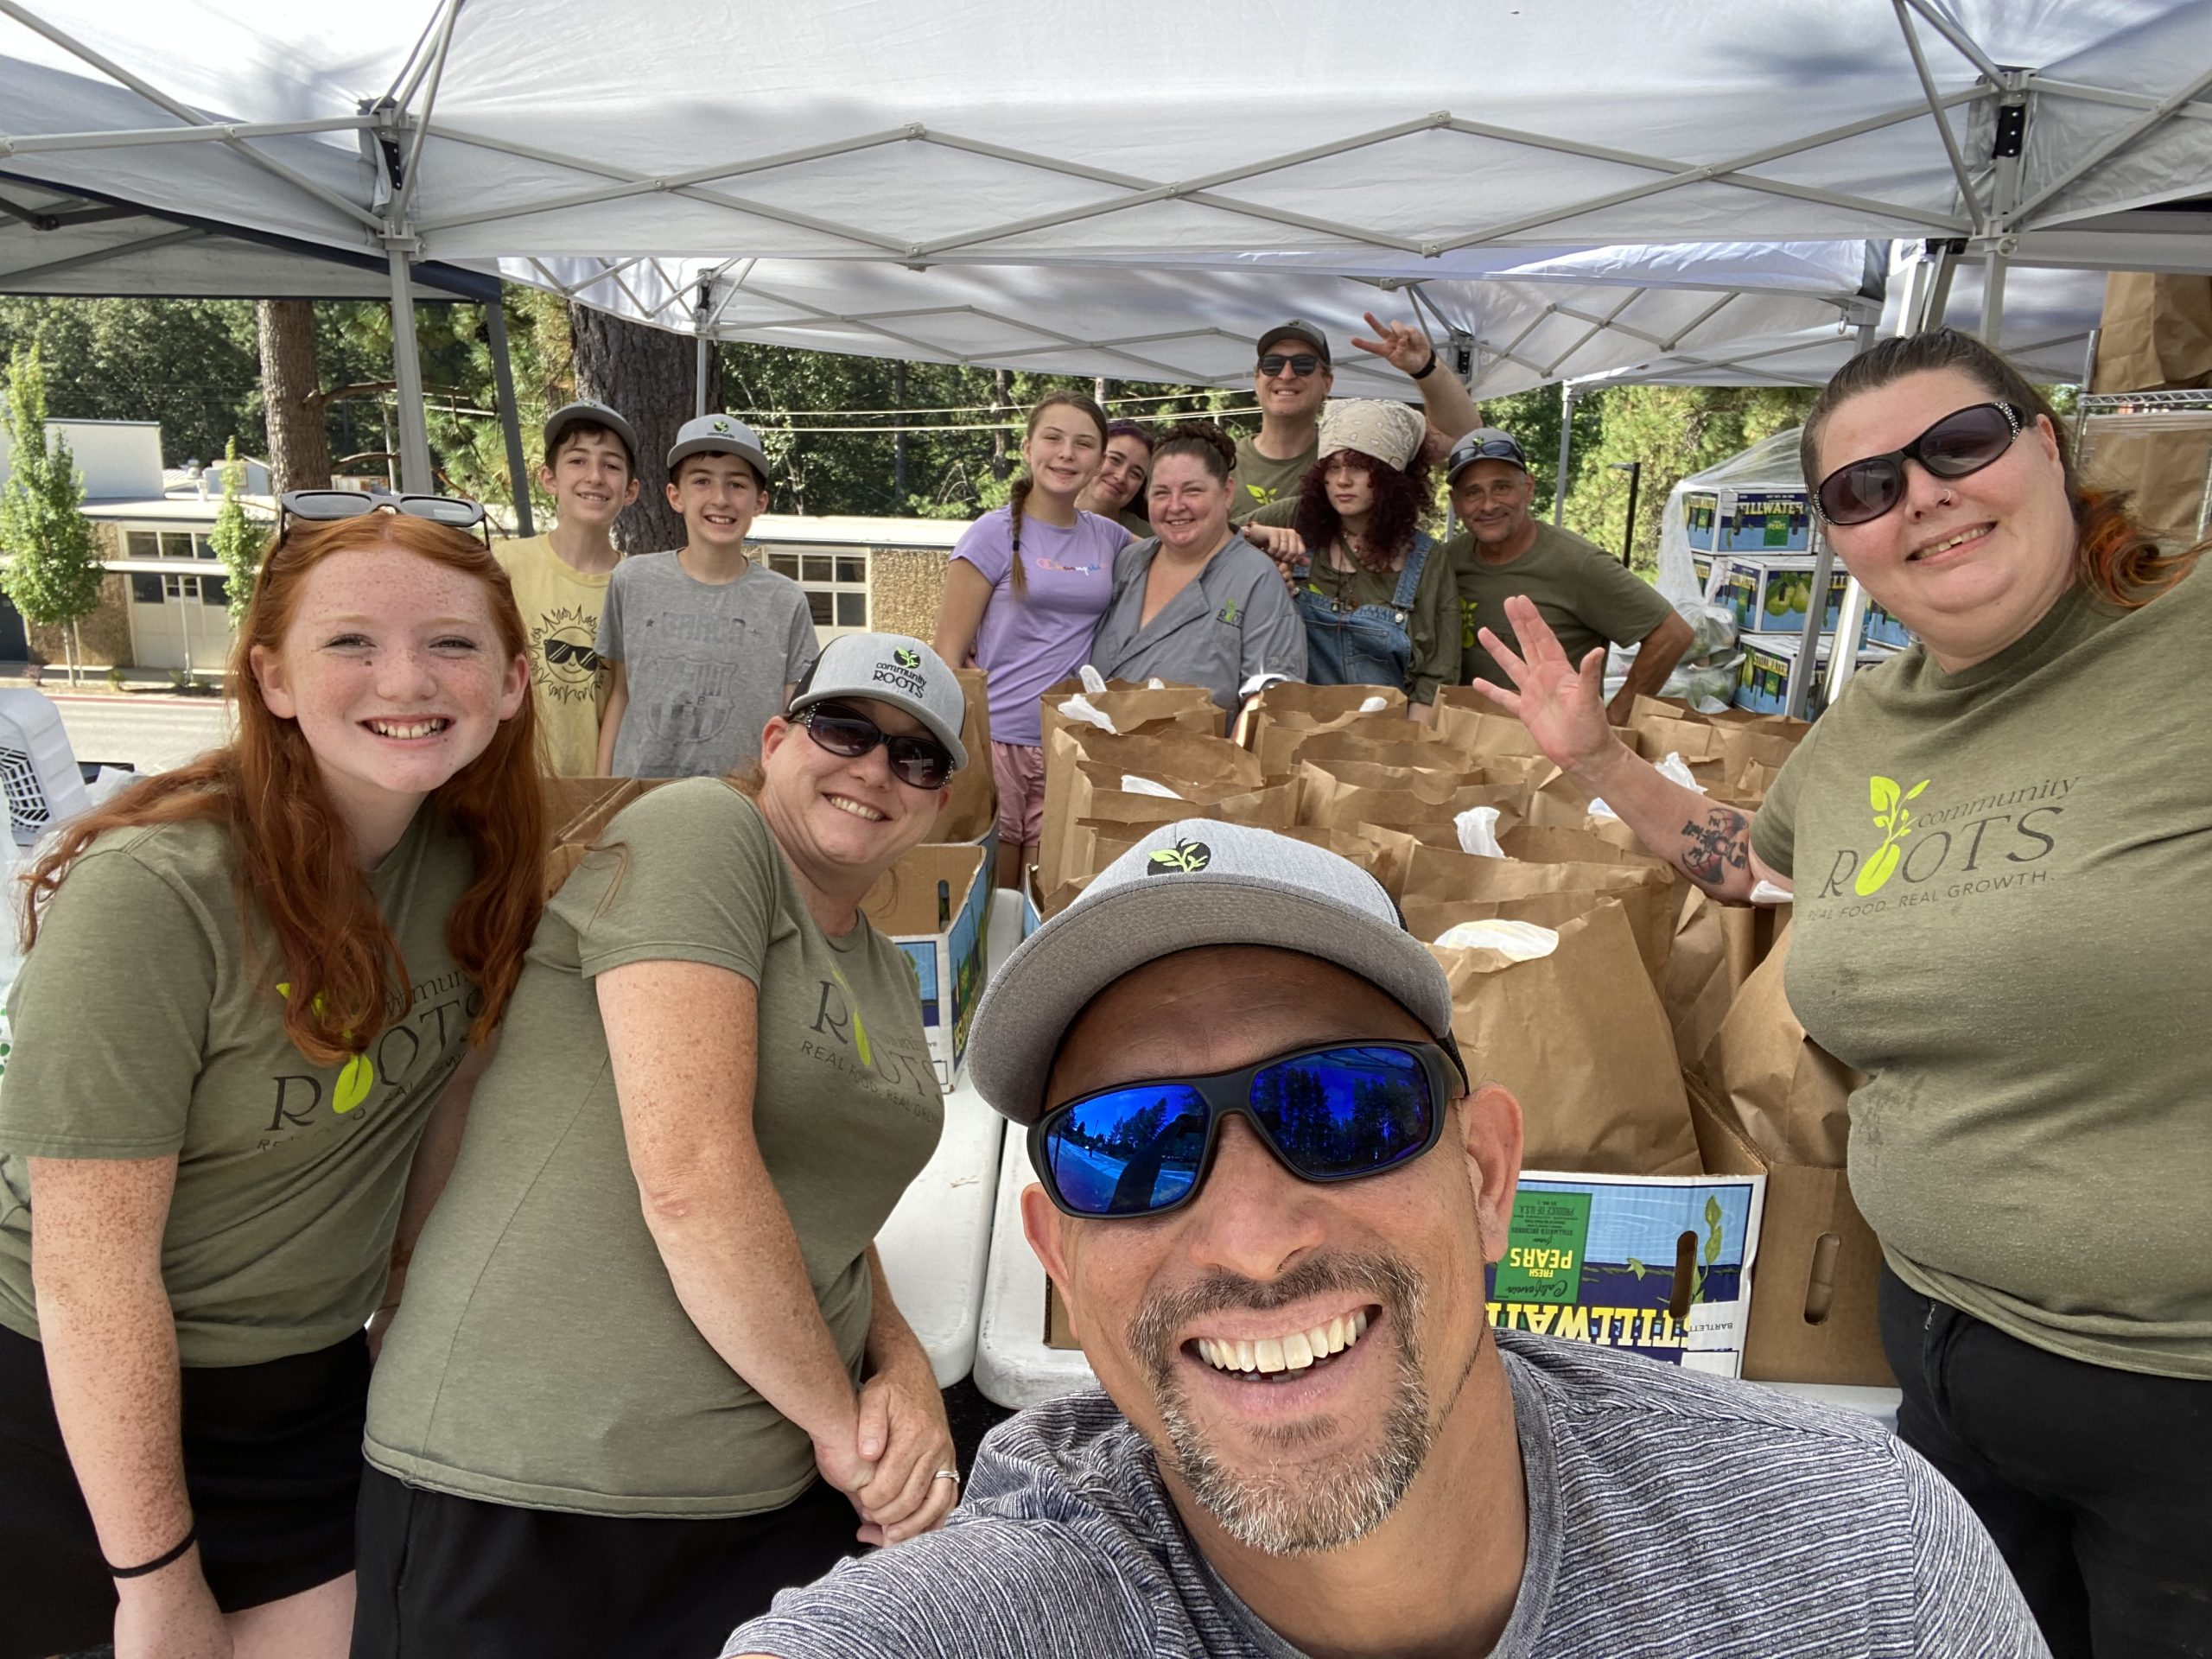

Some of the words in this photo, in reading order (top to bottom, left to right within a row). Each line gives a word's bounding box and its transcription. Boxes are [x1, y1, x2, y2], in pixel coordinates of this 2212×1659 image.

[1737, 502, 1804, 514] TILLWATER
[872, 670, 925, 699] ROOTS
[875, 662, 927, 688] community
[1917, 777, 2079, 829] community
[1899, 893, 1939, 908] REAL
[1948, 869, 2056, 899] GROWTH.
[801, 1039, 844, 1071] REAL
[1510, 1248, 1573, 1269] PEARS
[1529, 1268, 1554, 1278] FRESH
[1505, 1280, 1568, 1298] California
[1689, 1322, 1733, 1332] BARTLETT
